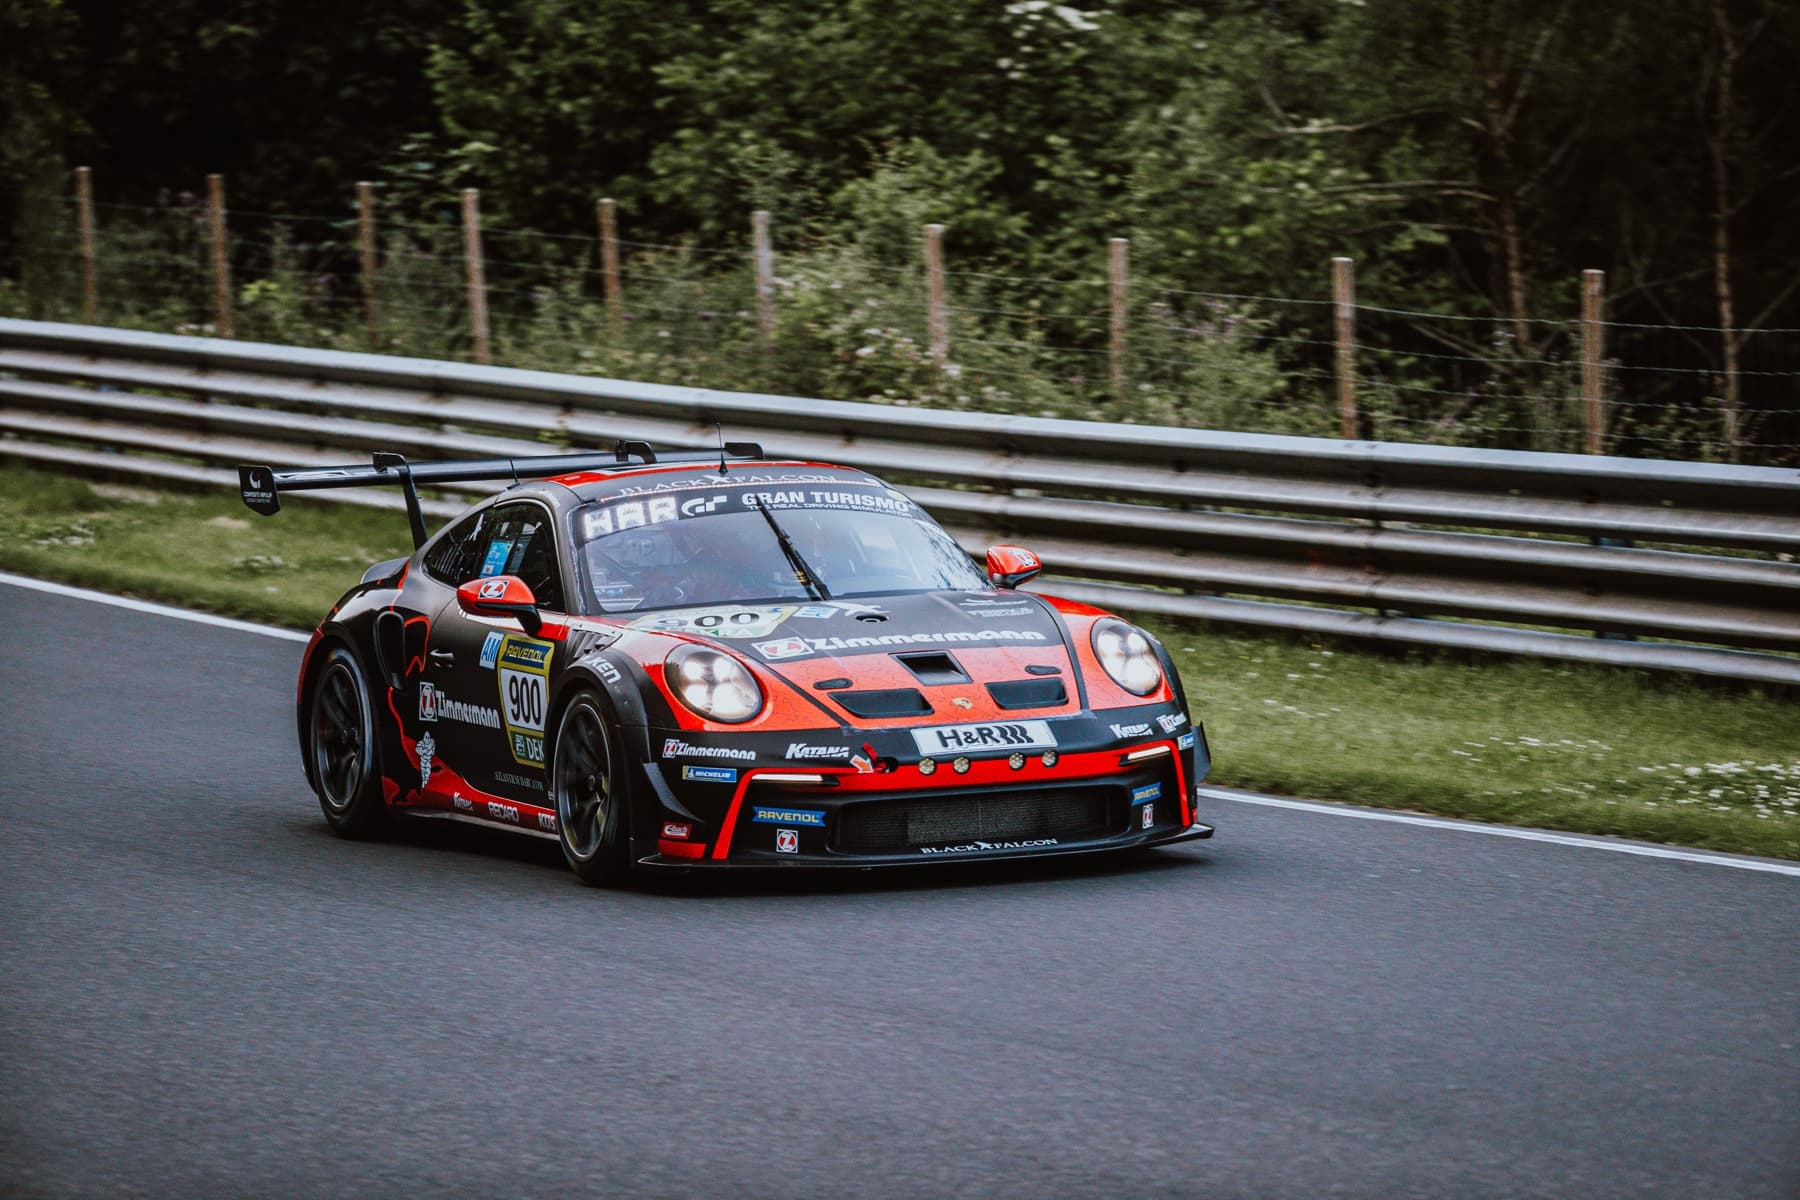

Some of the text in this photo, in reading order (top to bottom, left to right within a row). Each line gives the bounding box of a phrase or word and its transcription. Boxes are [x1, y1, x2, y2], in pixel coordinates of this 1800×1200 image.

[618, 474, 838, 495] BLACK FALCON
[742, 491, 910, 513] GRAN TURISMO
[805, 630, 1047, 650] Zimmermann
[436, 690, 501, 729] Zimmermann
[508, 674, 542, 726] 900
[525, 736, 545, 761] DEK
[677, 743, 756, 761] Zimmermann
[695, 770, 732, 779] MICHELIN
[757, 810, 820, 823] RAVENOL
[920, 837, 1059, 855] BLACK FALCON
